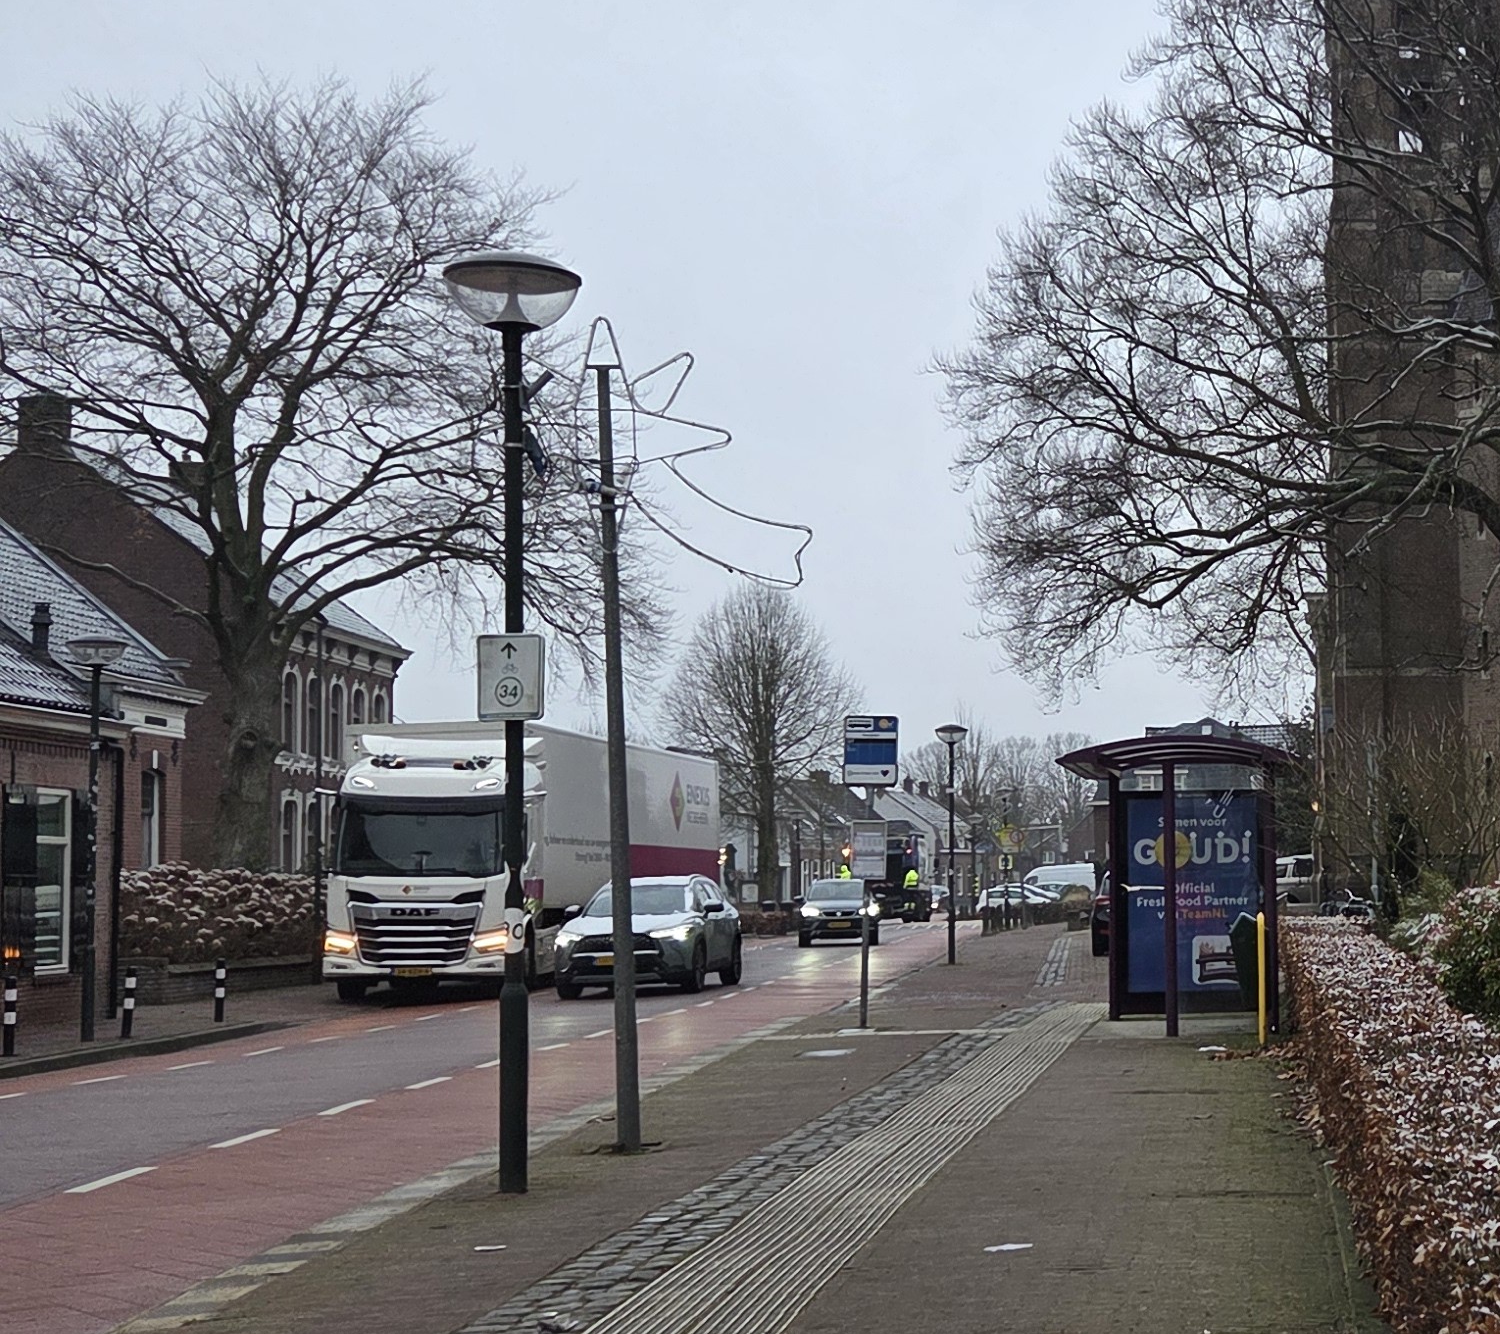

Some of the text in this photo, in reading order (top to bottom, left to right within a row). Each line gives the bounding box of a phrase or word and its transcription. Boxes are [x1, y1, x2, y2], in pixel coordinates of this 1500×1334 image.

[499, 684, 518, 700] 34
[1157, 816, 1227, 827] Smen voor
[1204, 895, 1249, 906] Partner
[390, 907, 440, 916] DAF
[1182, 908, 1229, 919] TeamNL
